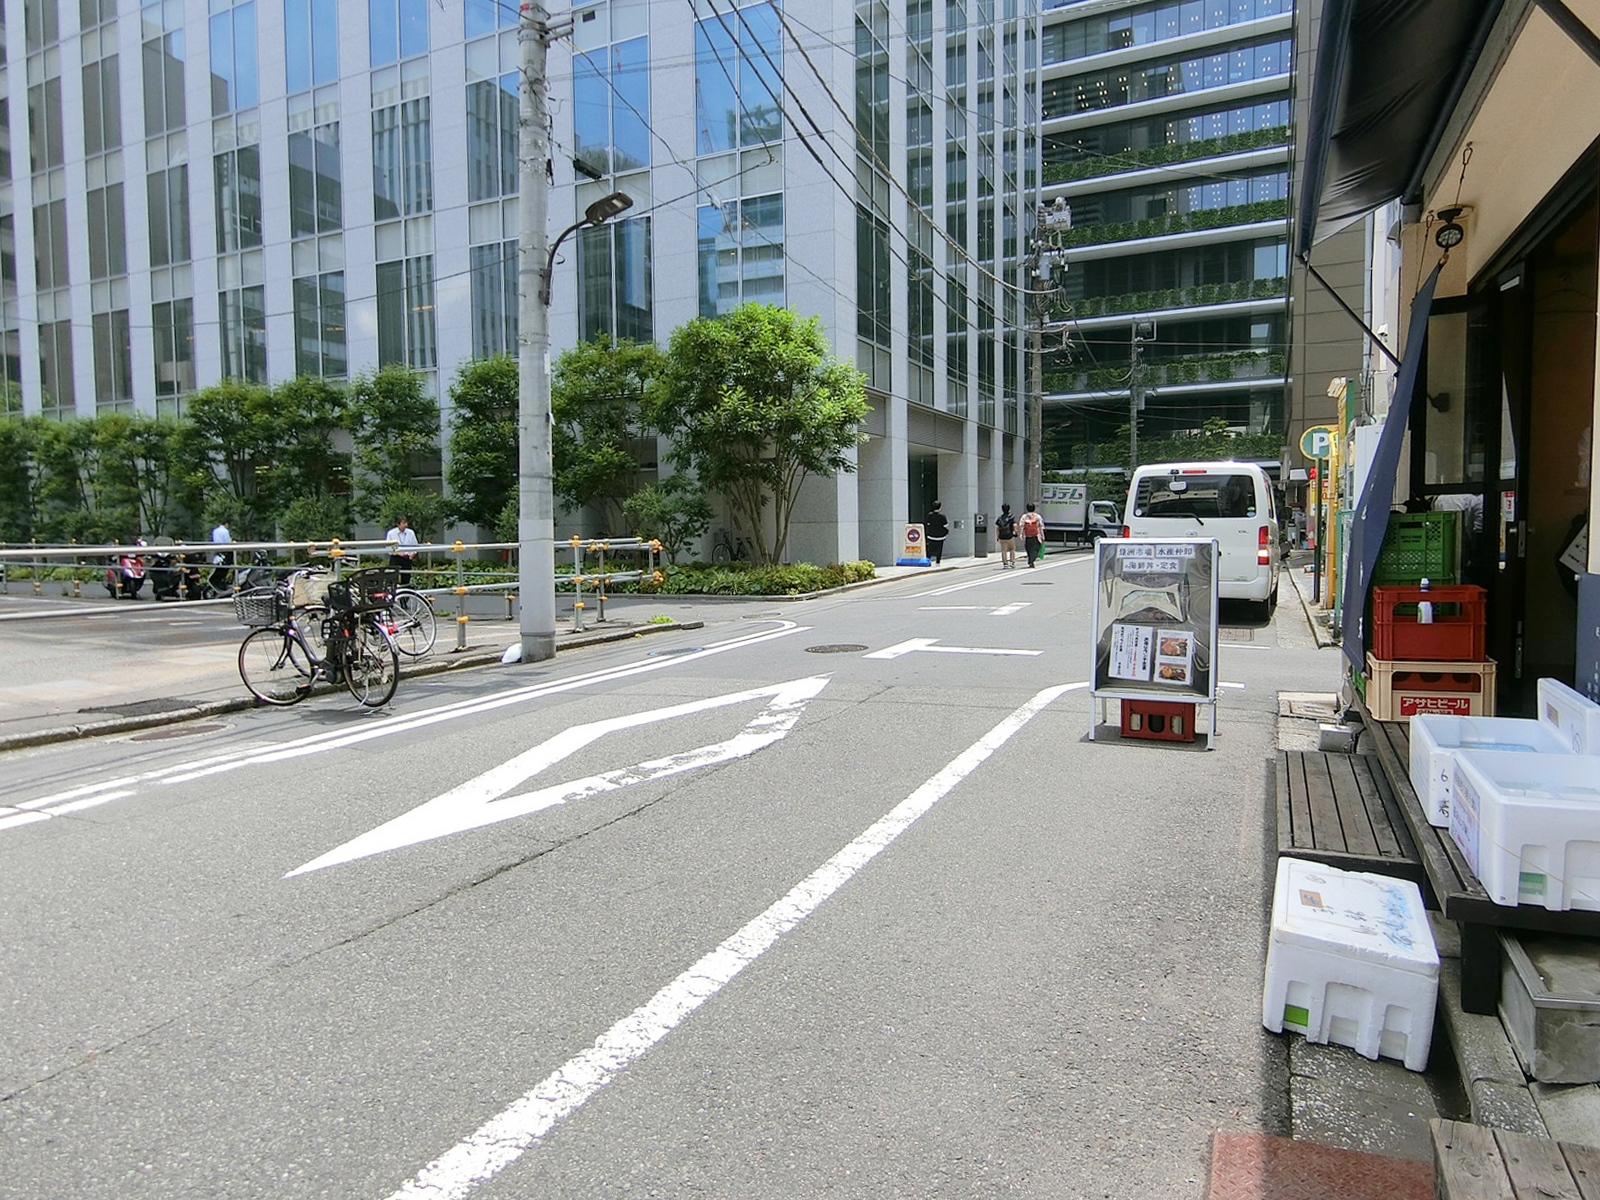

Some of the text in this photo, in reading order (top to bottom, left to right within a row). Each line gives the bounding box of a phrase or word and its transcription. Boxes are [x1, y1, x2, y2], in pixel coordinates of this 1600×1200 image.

[1312, 432, 1330, 455] P
[1157, 547, 1193, 556] 水産仲卸
[1402, 698, 1468, 709] アサヒビール
